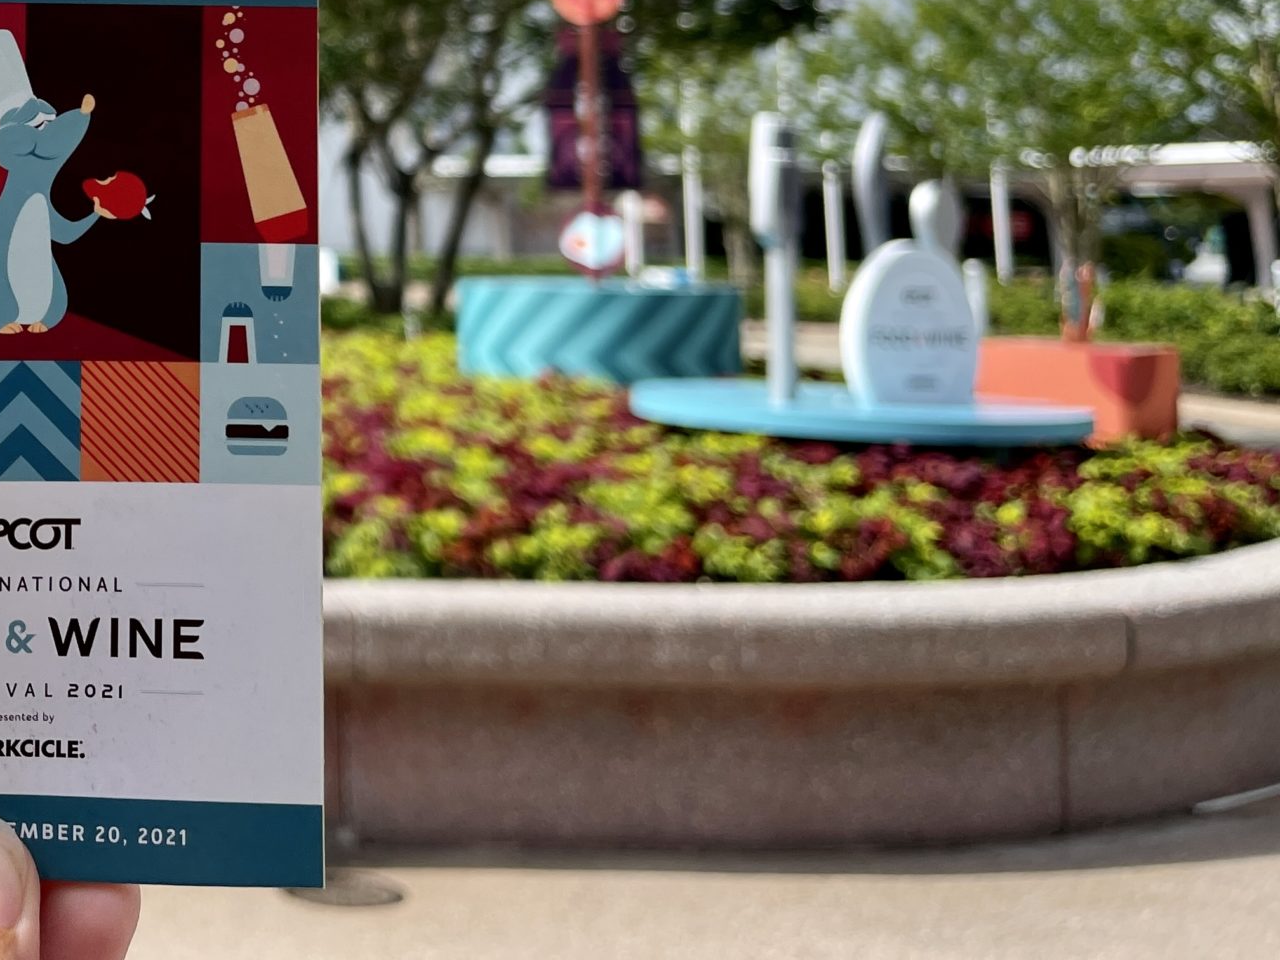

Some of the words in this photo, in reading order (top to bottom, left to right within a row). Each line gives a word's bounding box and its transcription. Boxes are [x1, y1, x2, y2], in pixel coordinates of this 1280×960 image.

[5, 619, 37, 655] &
[47, 616, 205, 660] WINE
[67, 683, 123, 699] 2021
[42, 711, 55, 725] by
[95, 825, 128, 846] 20,
[137, 827, 187, 846] 2021
